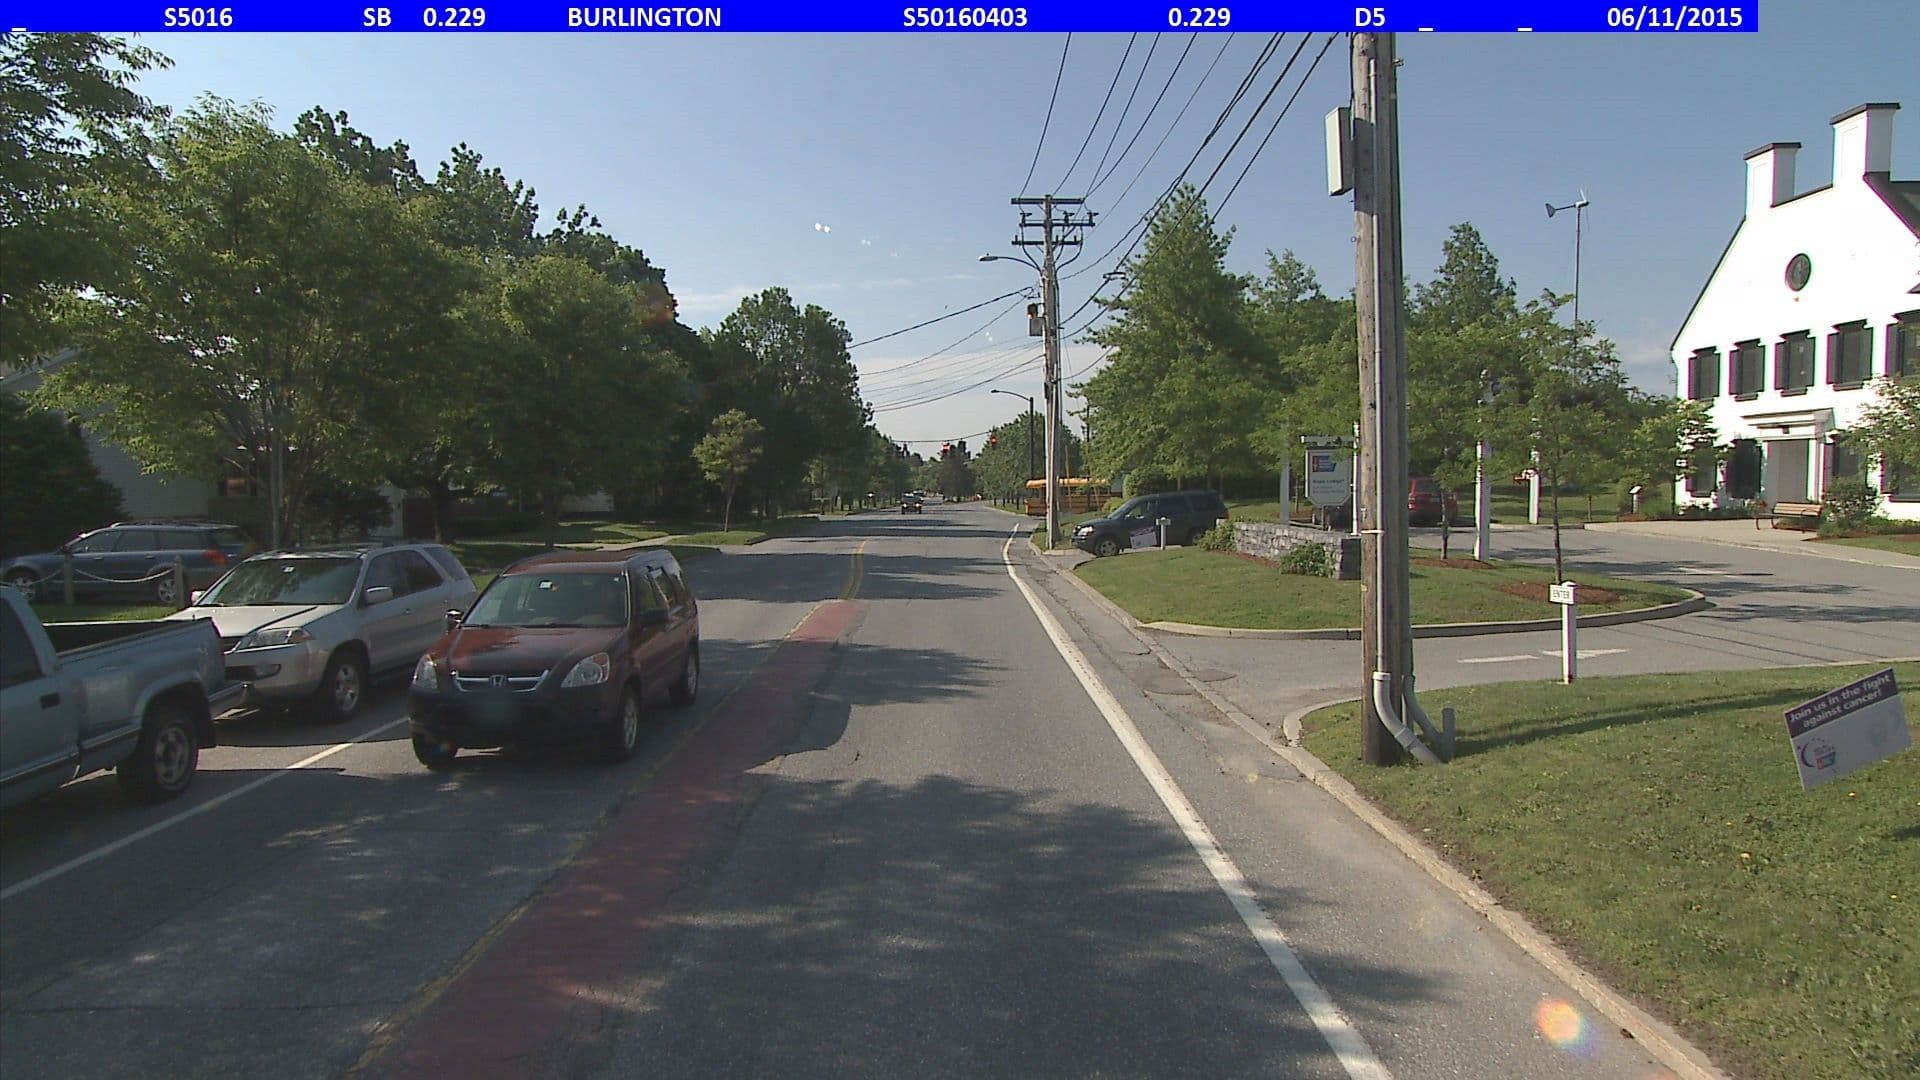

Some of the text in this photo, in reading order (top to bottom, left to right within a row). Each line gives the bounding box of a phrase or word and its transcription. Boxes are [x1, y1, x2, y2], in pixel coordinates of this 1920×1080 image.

[1814, 701, 1827, 711] us
[1828, 696, 1840, 705] in
[1841, 687, 1861, 699] the
[1863, 674, 1891, 691] fight
[1803, 705, 1842, 728] against
